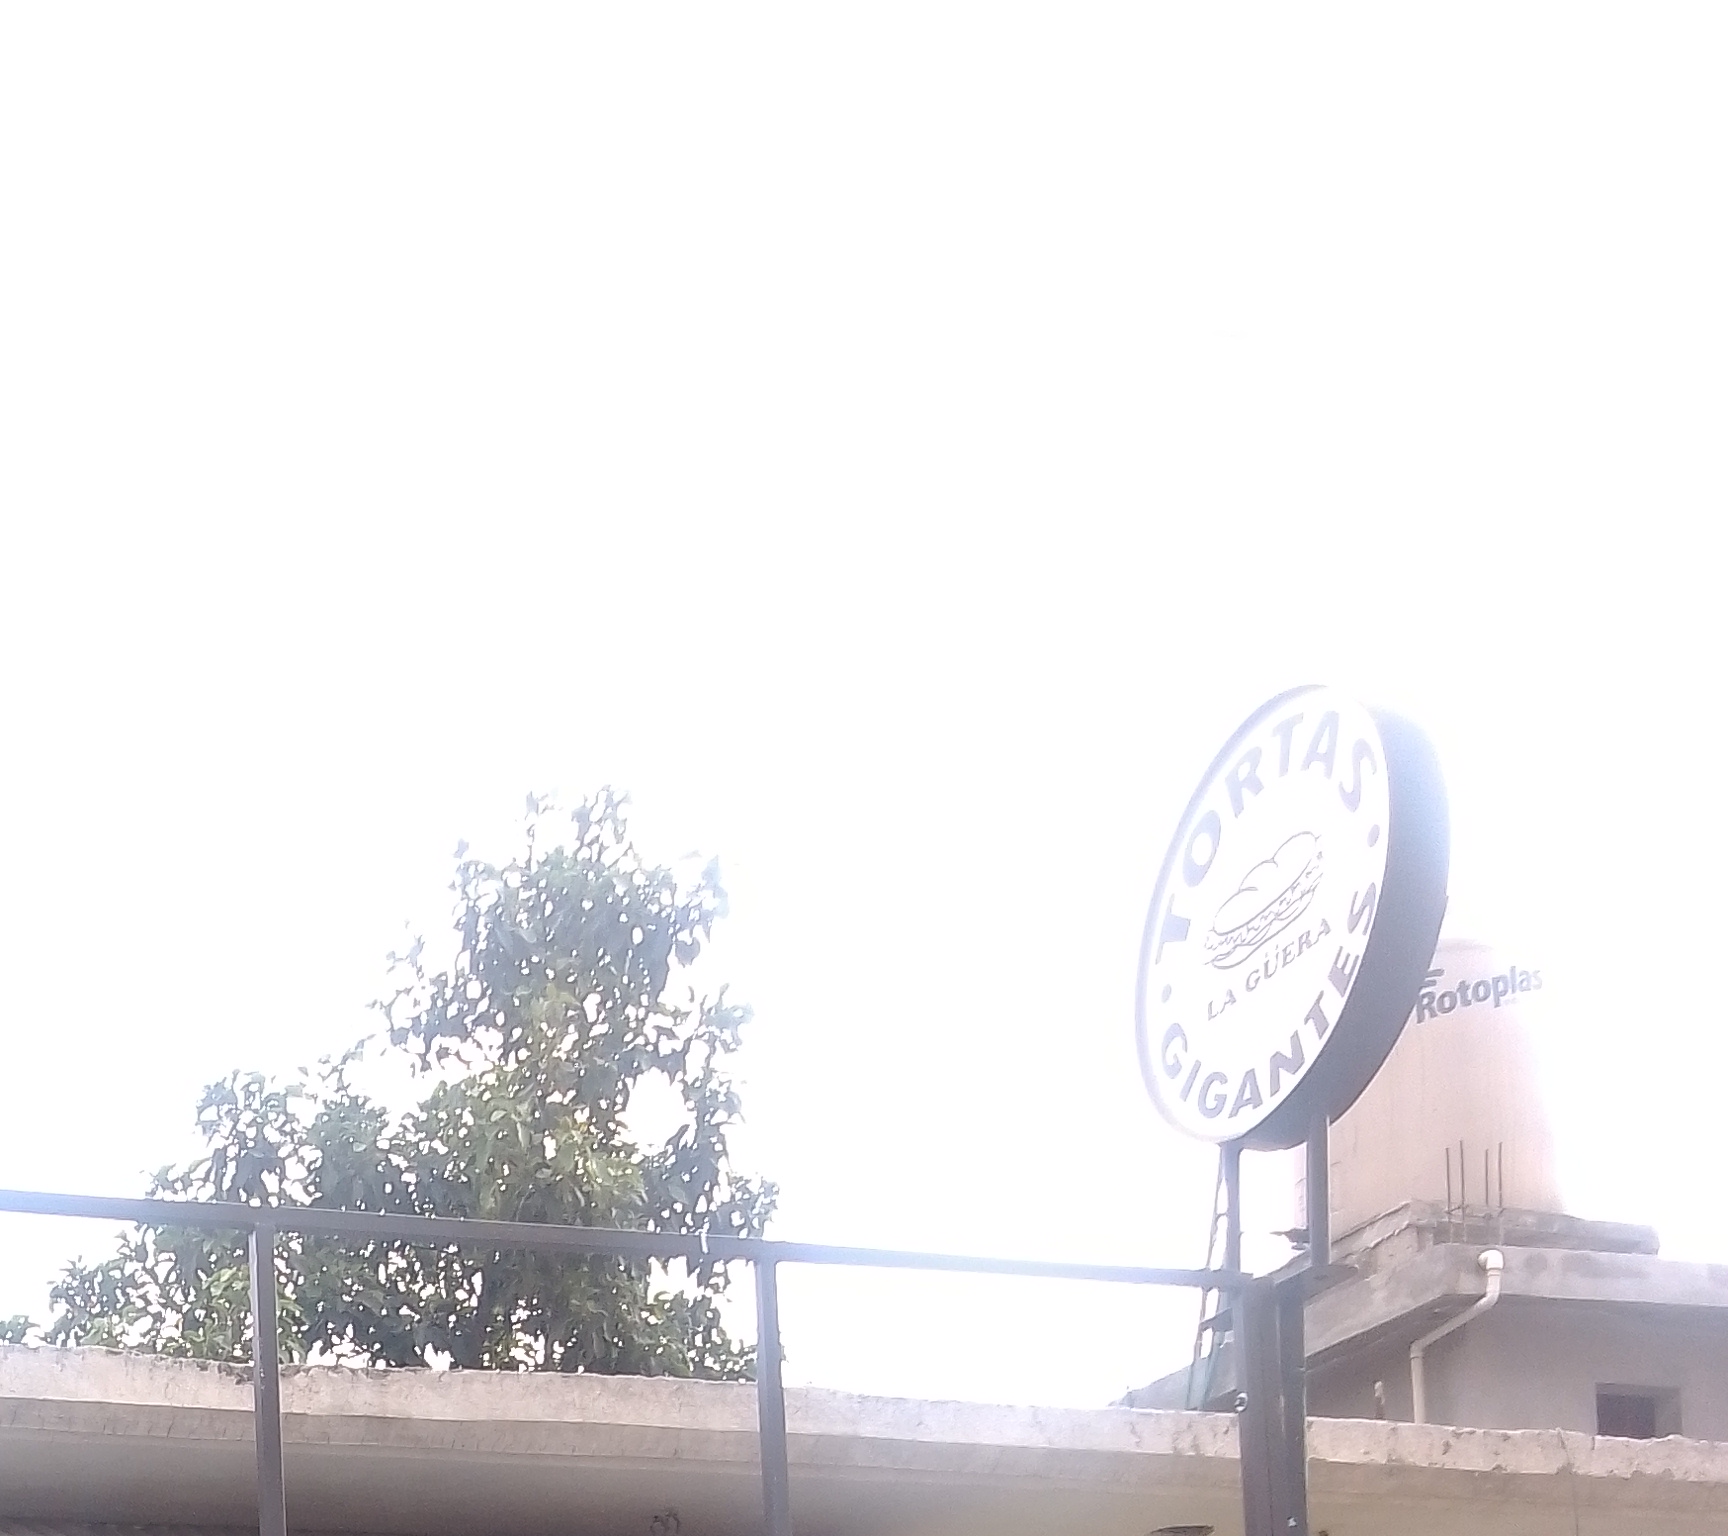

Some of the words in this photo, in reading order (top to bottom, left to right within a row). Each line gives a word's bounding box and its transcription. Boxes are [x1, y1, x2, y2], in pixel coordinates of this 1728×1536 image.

[1154, 711, 1377, 965] TORTAS
[1161, 881, 1377, 1119] GIGANTES
[1207, 988, 1237, 1021] LA
[1245, 918, 1332, 992] GÜERA
[1416, 965, 1544, 1025] Rotoplas
